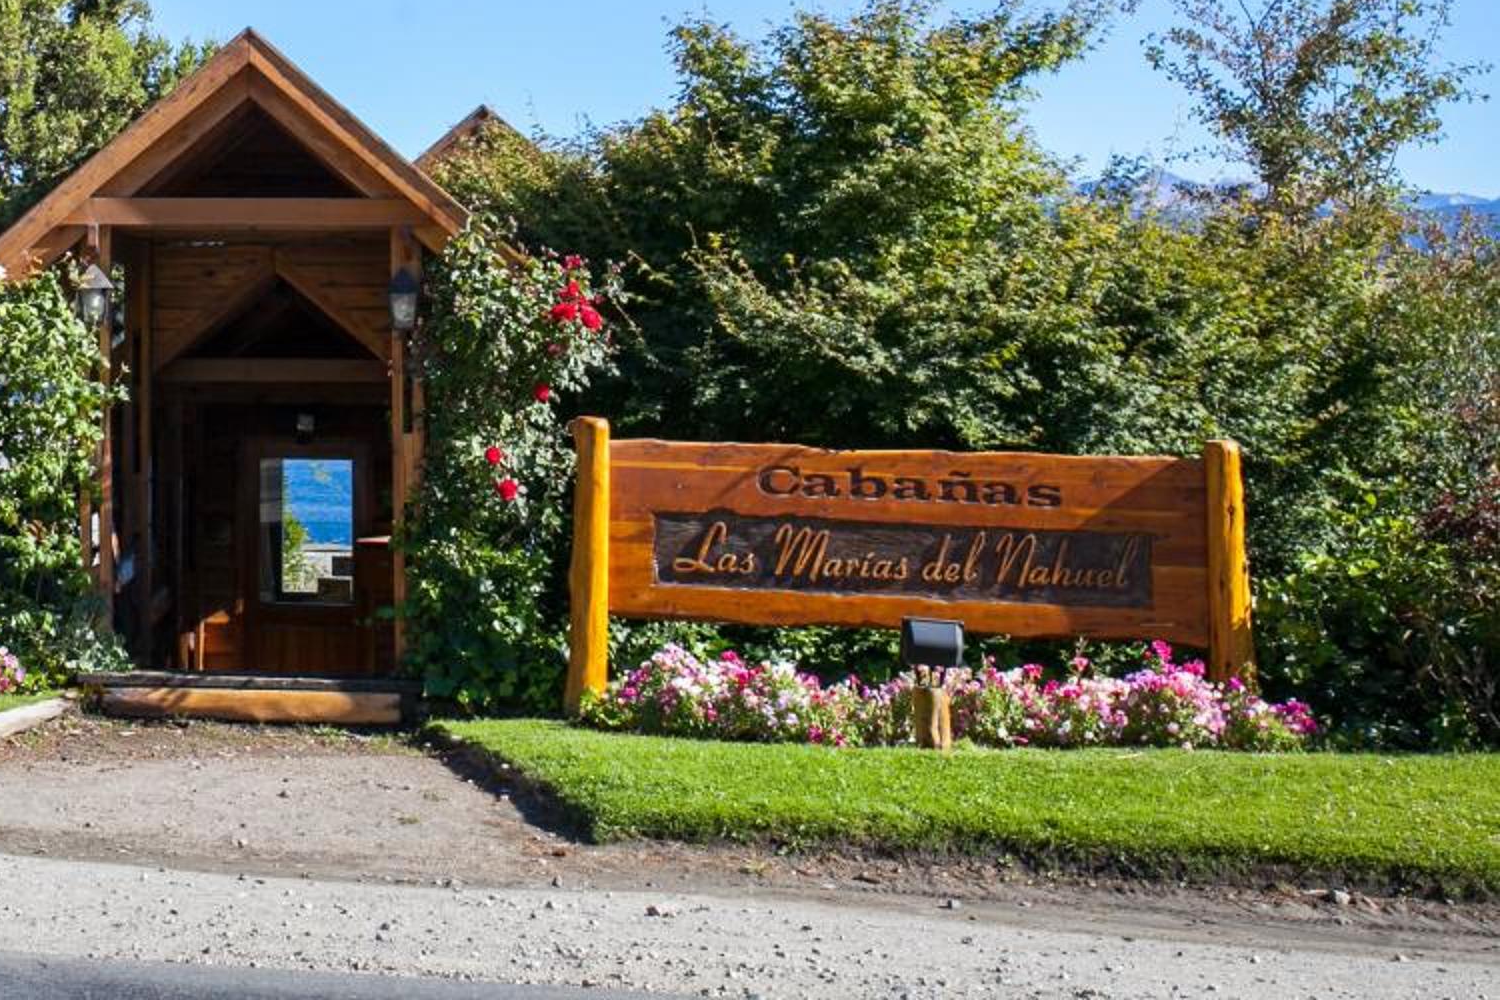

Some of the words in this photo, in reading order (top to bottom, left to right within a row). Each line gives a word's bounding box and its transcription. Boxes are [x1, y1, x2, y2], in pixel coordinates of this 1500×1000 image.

[756, 464, 1061, 509] Cabañas
[673, 520, 757, 574] Las
[774, 522, 908, 583] Marías
[922, 531, 987, 587] del
[995, 532, 1140, 589] Nahuel
